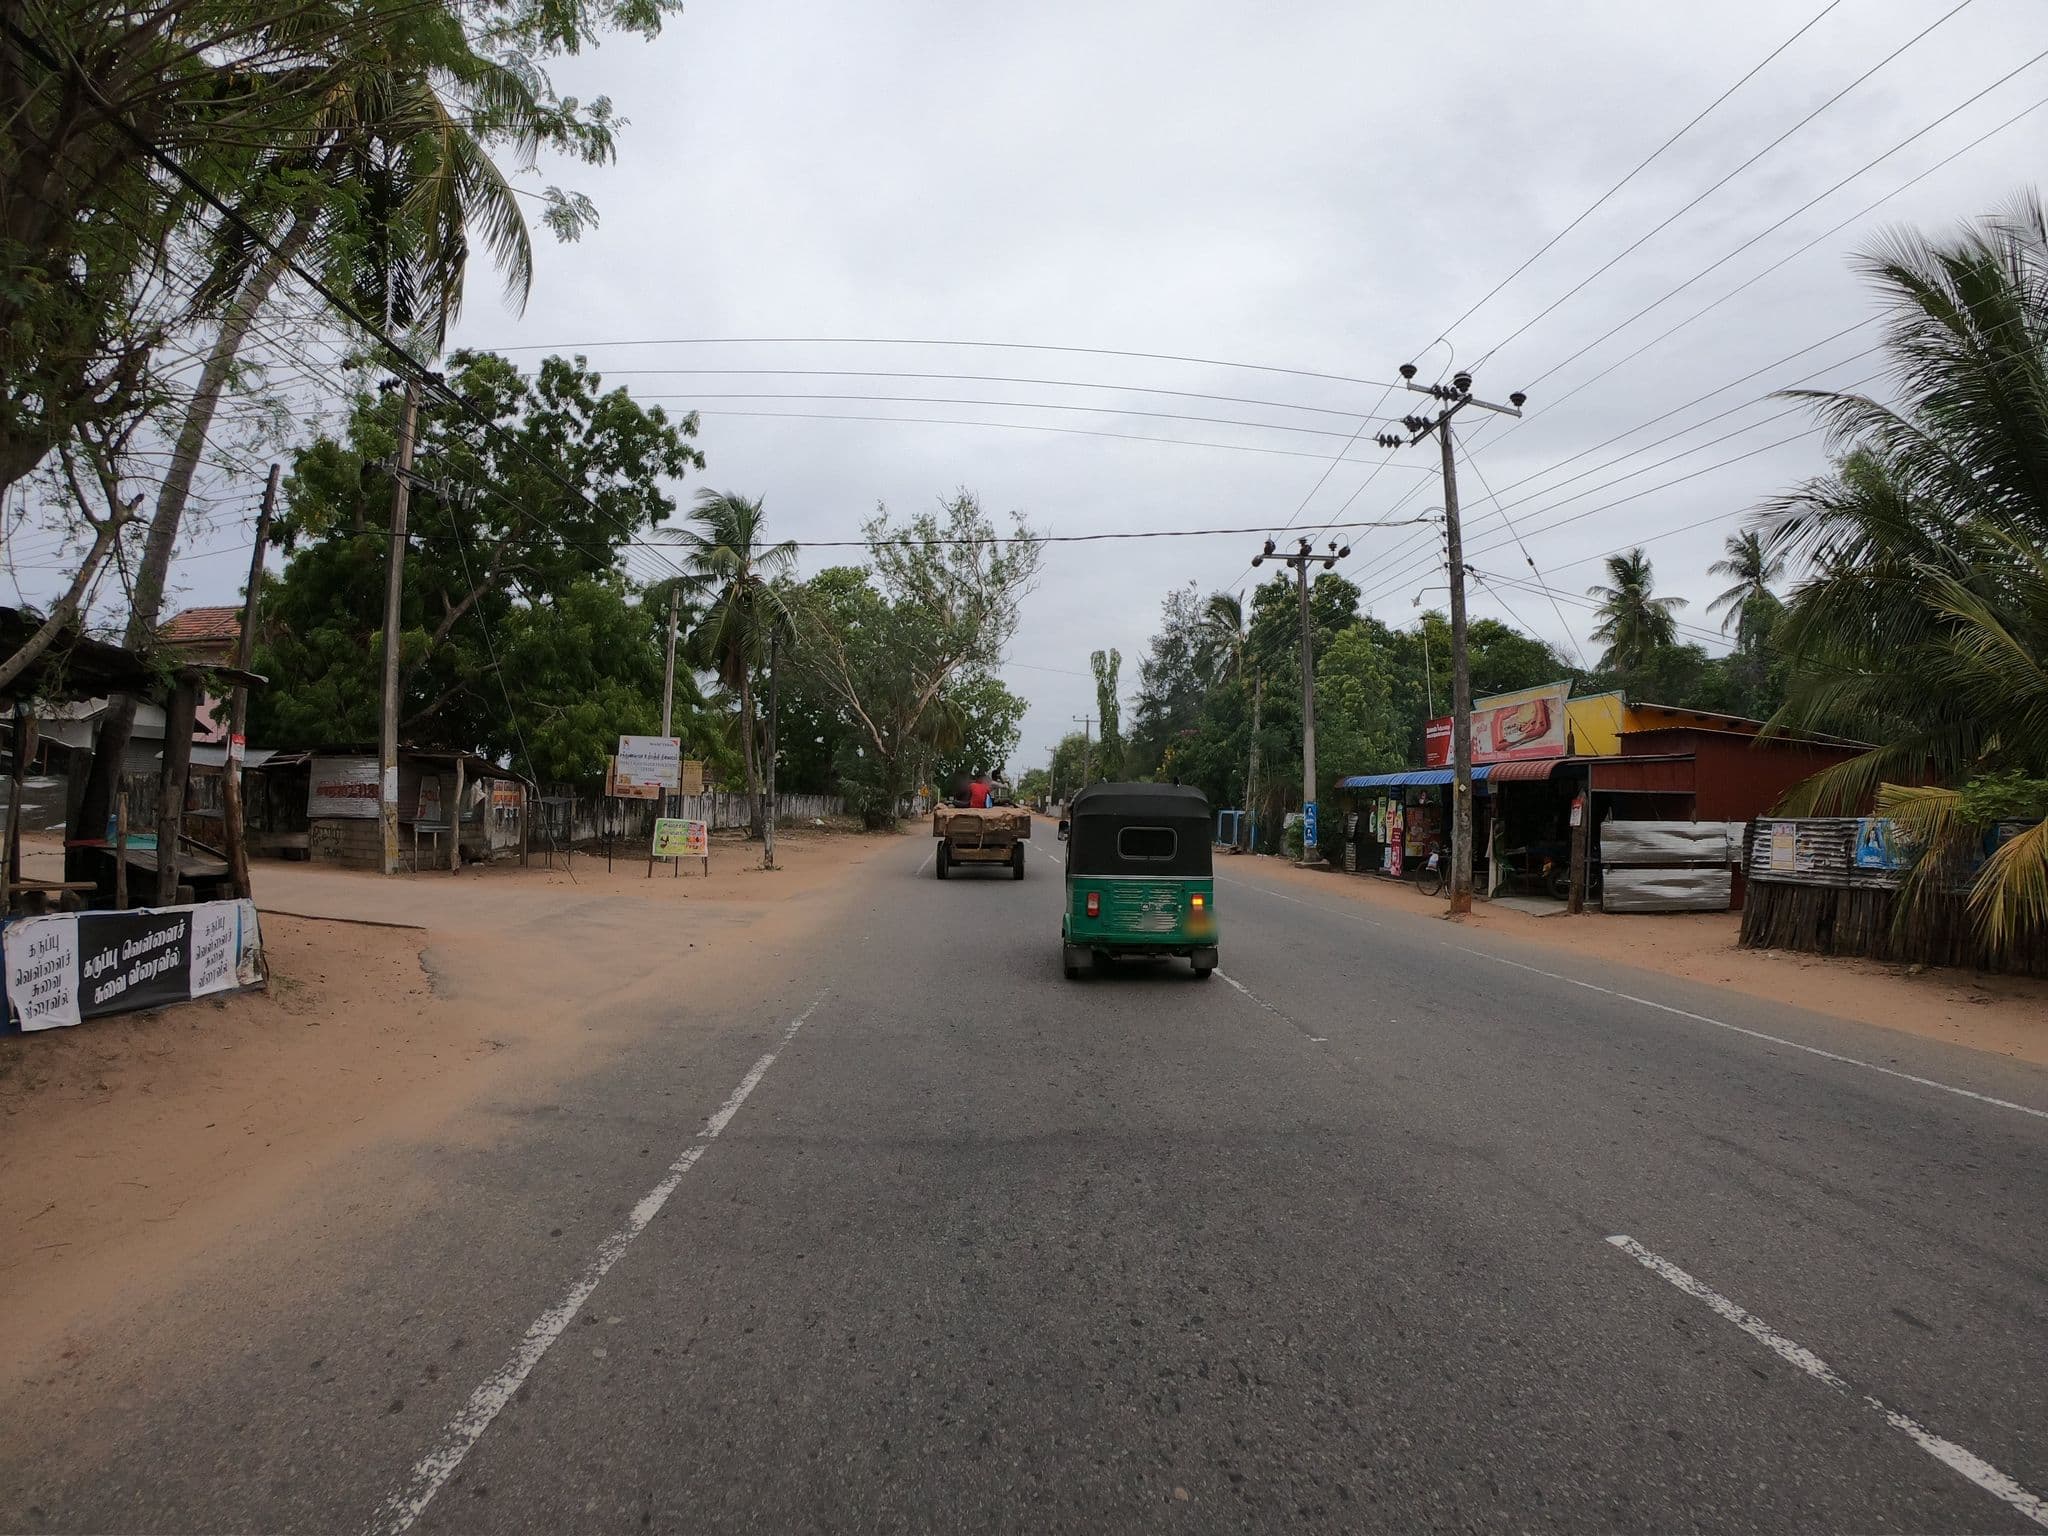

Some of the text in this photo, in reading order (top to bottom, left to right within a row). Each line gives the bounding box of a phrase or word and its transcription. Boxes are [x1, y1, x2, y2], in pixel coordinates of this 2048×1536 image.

[83, 918, 186, 979] கருப்பு வெள்ளைச்
[129, 946, 181, 986] விரைவில்
